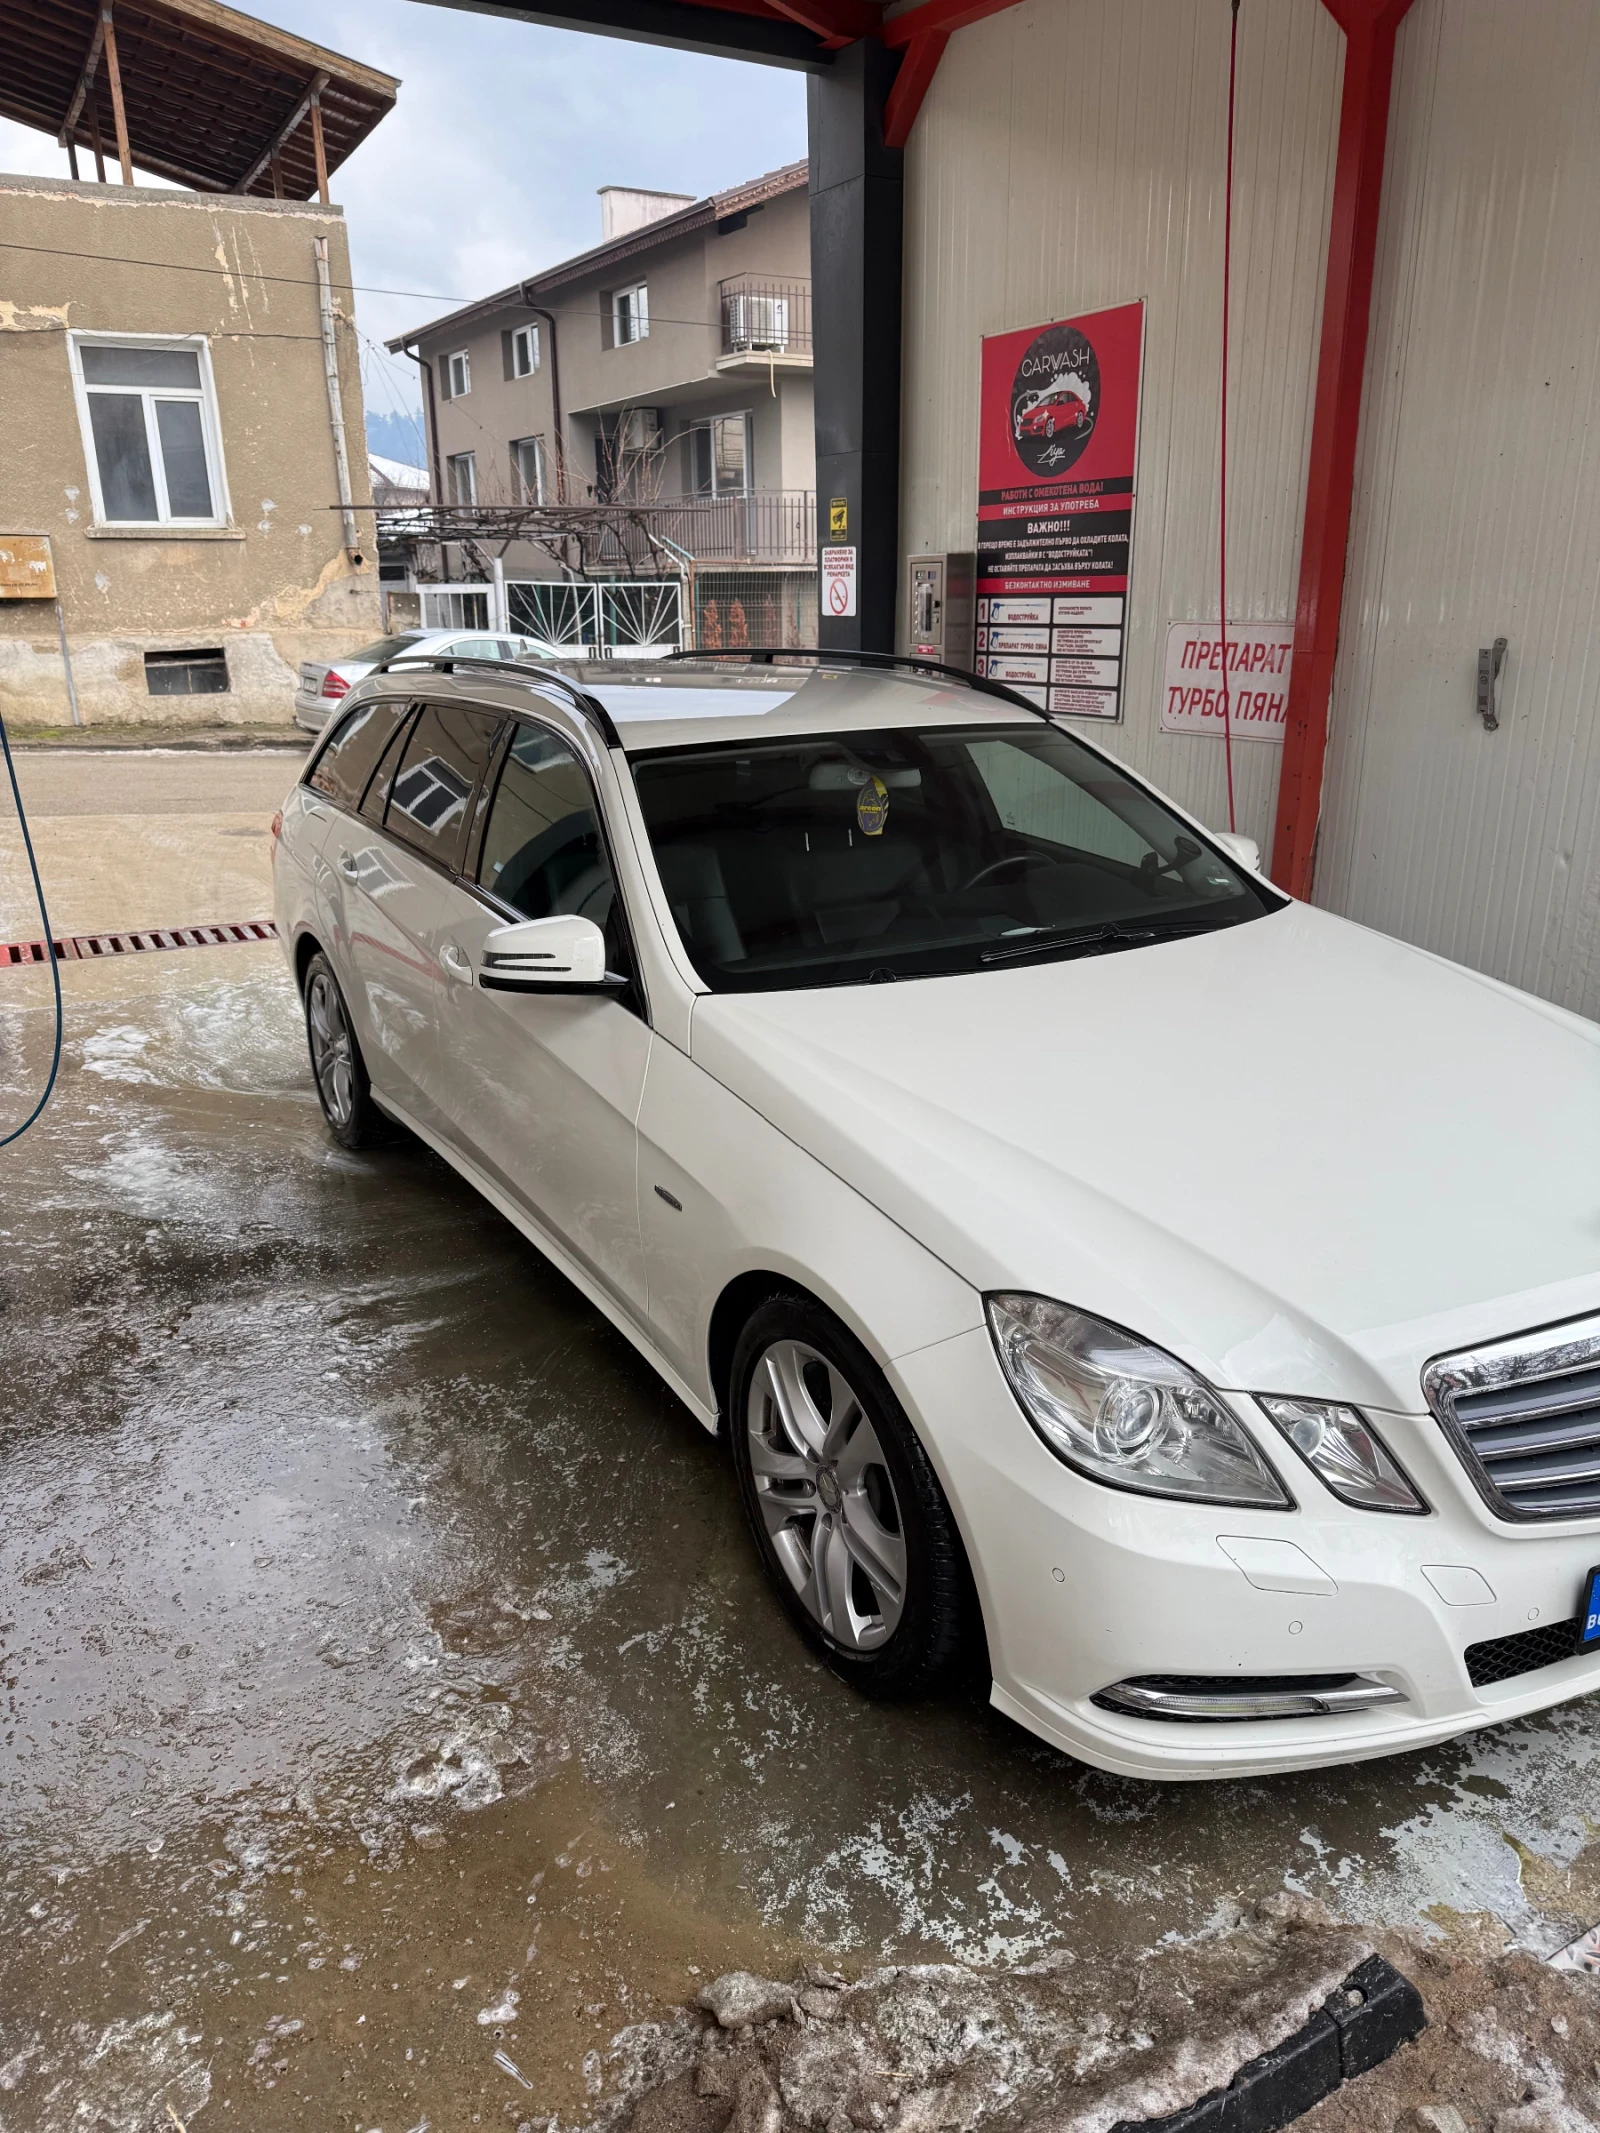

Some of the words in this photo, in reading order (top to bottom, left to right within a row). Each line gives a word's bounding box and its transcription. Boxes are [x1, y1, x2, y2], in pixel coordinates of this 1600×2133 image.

[1021, 347, 1090, 377] CARWASH
[1001, 490, 1028, 500] РАБОТИ
[1028, 489, 1033, 498] С
[1034, 484, 1078, 498] ОМЕКОТЕНА
[1078, 482, 1104, 494] ВОДА!
[1003, 503, 1049, 515] ИНСТРУКЦИЯ
[1049, 502, 1059, 511] ЗА
[1060, 499, 1100, 511] УПОТРЕБА
[1027, 520, 1071, 534] ВАЖНО!!!
[998, 540, 1013, 549] ВРЕМЕ
[1017, 538, 1055, 548] ЗАДЪЛЖИТЕЛНО
[1055, 537, 1072, 546] ПЪРВО
[1072, 536, 1080, 545] ДА
[1080, 535, 1107, 545] ОХЛАДИТЕ
[1018, 563, 1044, 572] ПРЕПАРАТА
[1052, 562, 1074, 571] ЗАСЪХВА
[1074, 561, 1091, 570] ВЪРХУ
[1004, 581, 1052, 590] БЕЗКОНТАКТНО
[1053, 579, 1090, 589] ИЗМИВАНЕ
[980, 602, 986, 620] 1
[1007, 612, 1039, 621] ВОДОСТРУЙКА
[978, 630, 986, 648] 2
[998, 642, 1019, 650] ПРЕПАРАТ
[1020, 642, 1034, 650] ТУРБО
[1181, 641, 1292, 674] ПРЕПАРАТ
[977, 658, 985, 675] 3
[1005, 671, 1036, 679] ВОДОСТРУЙКА
[1168, 686, 1229, 718] ТУРБО
